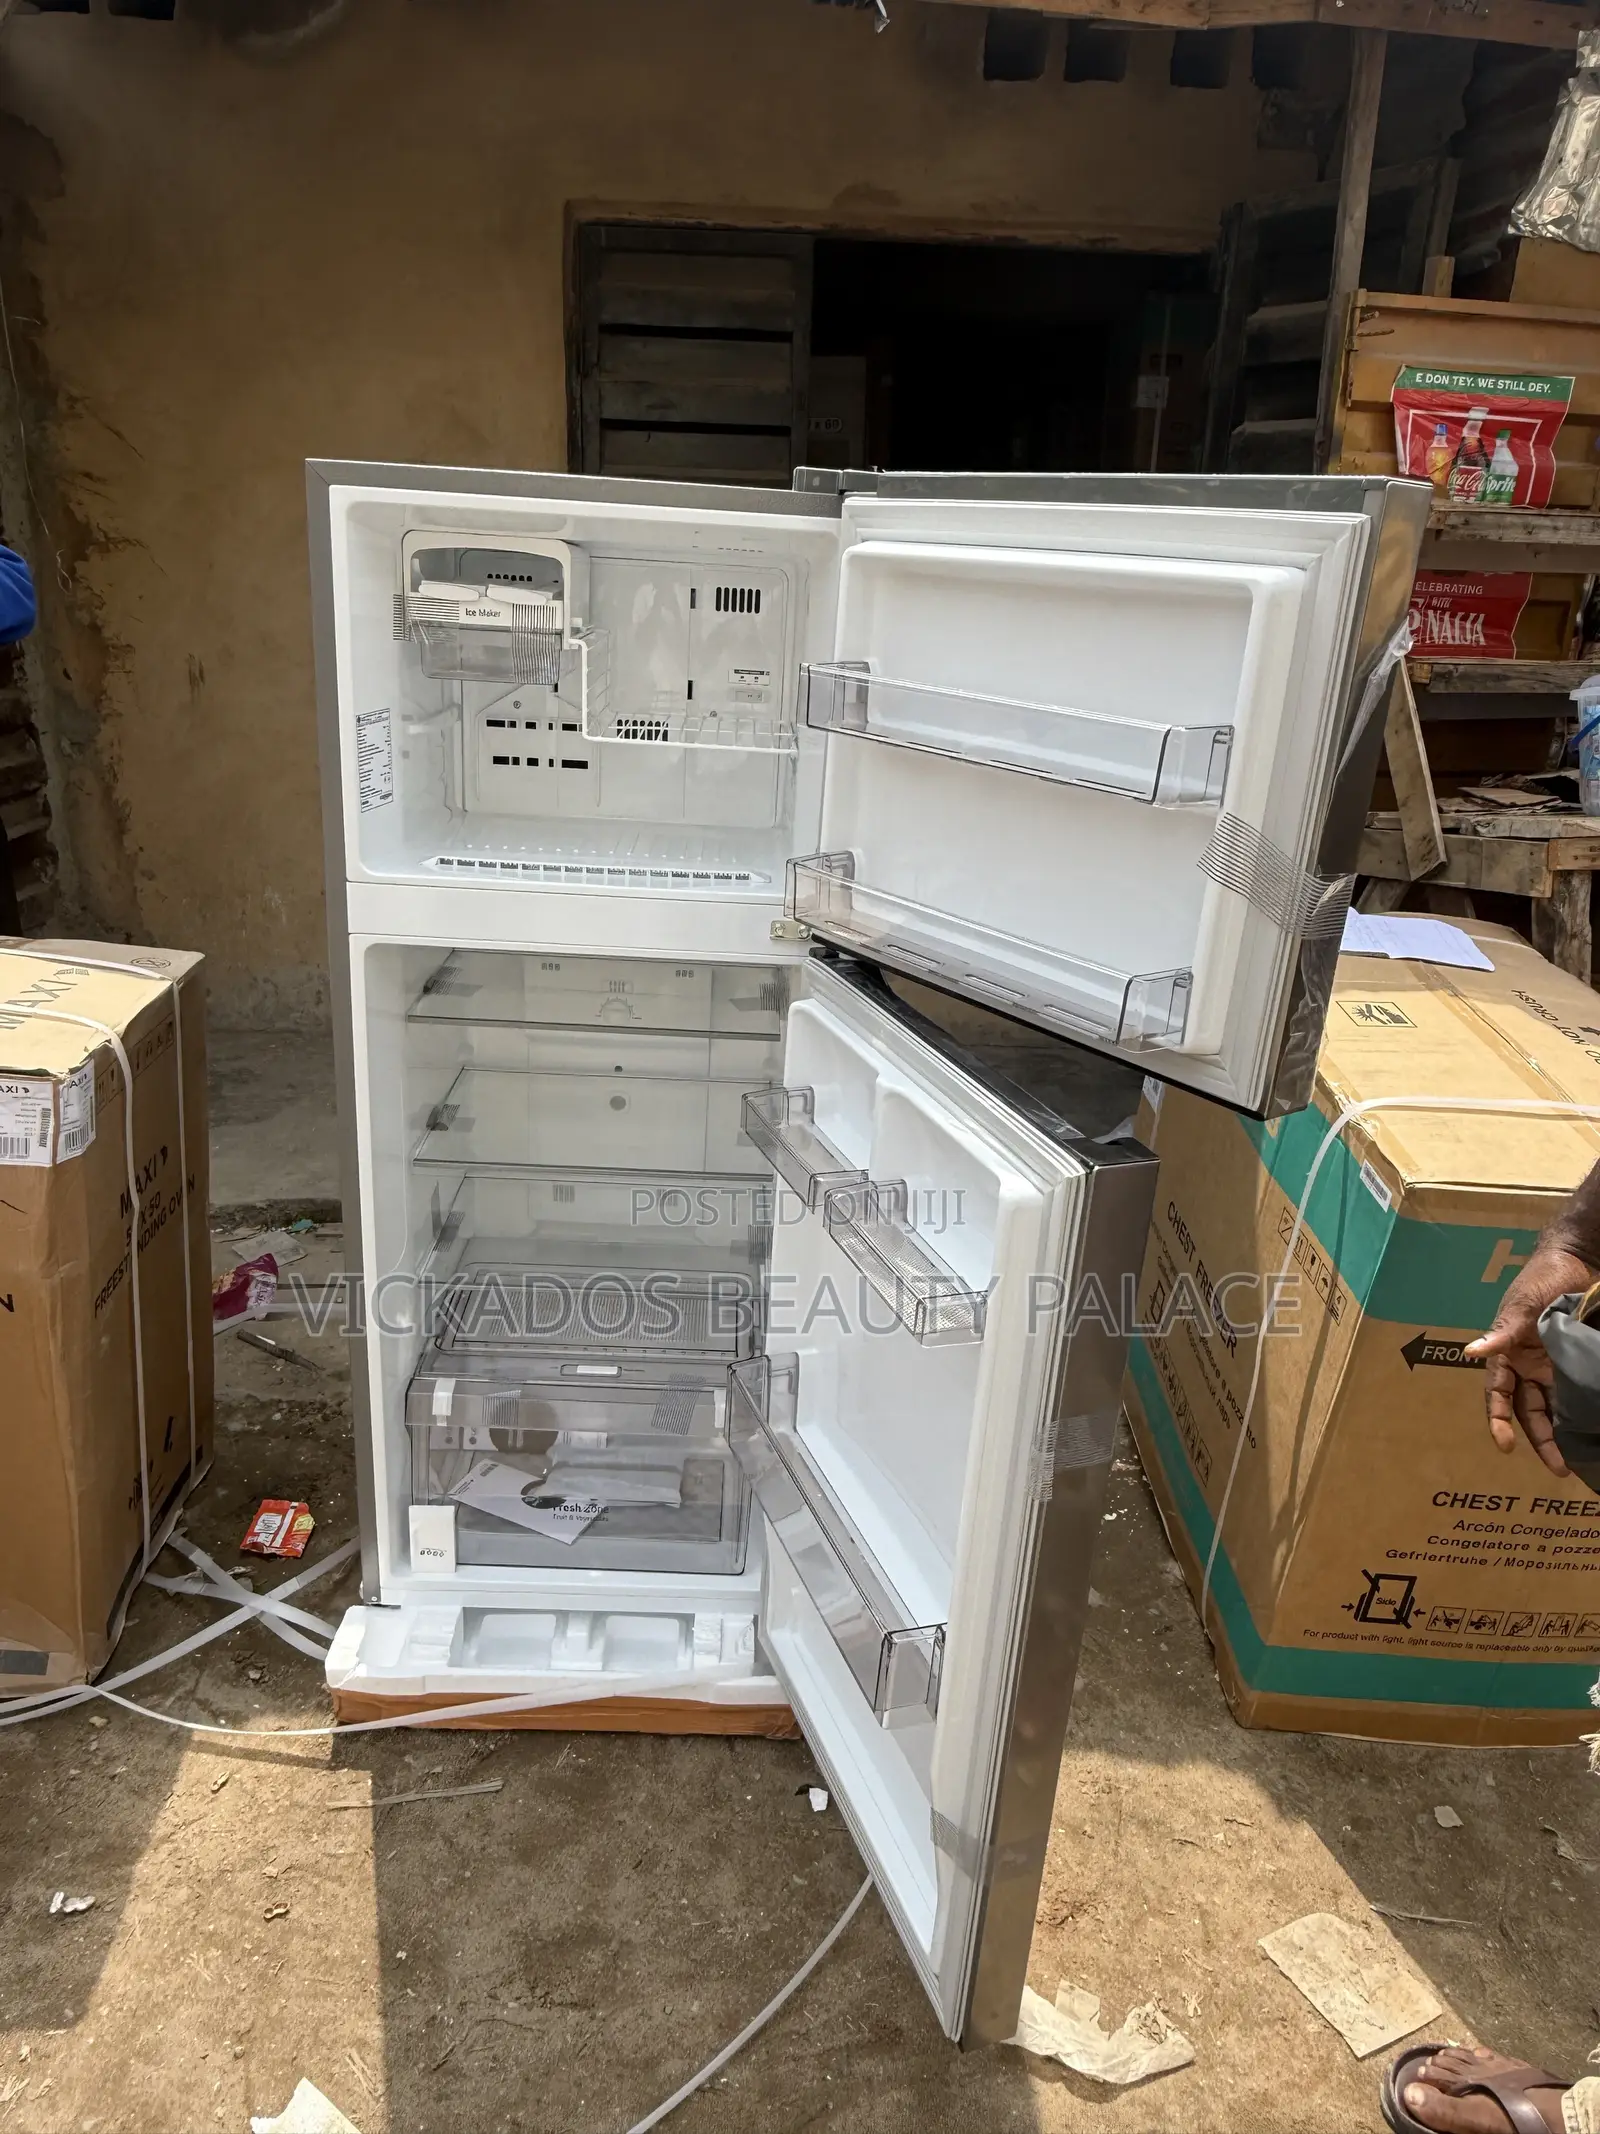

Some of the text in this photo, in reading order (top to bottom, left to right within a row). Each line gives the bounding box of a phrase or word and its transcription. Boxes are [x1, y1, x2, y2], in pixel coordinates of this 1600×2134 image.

[1416, 373, 1551, 393] E DON TEY. WE STILL DEY.
[1415, 581, 1483, 595] ELEBRATING
[465, 607, 501, 618] Ice Maker
[1425, 609, 1486, 647] NAIJA
[1511, 989, 1559, 1021] CRUSH
[1167, 1201, 1197, 1264] CHEST
[94, 1173, 195, 1319] FREESTNDING OVN
[1431, 1490, 1521, 1513] CHEST
[1452, 1519, 1505, 1535] Arcón
[1427, 1535, 1530, 1551] Congelatore
[1537, 1544, 1547, 1553] a
[1385, 1549, 1488, 1567] Gefriertruhe
[1375, 1597, 1397, 1606] Side
[1303, 1629, 1320, 1637] For
[1321, 1631, 1359, 1642] product
[1360, 1633, 1380, 1642] with
[1407, 1637, 1428, 1647] light
[1430, 1640, 1463, 1649] source
[1465, 1641, 1474, 1650] is
[1475, 1642, 1530, 1652] replaceable
[1532, 1644, 1551, 1653] only
[1553, 1645, 1566, 1654] by
